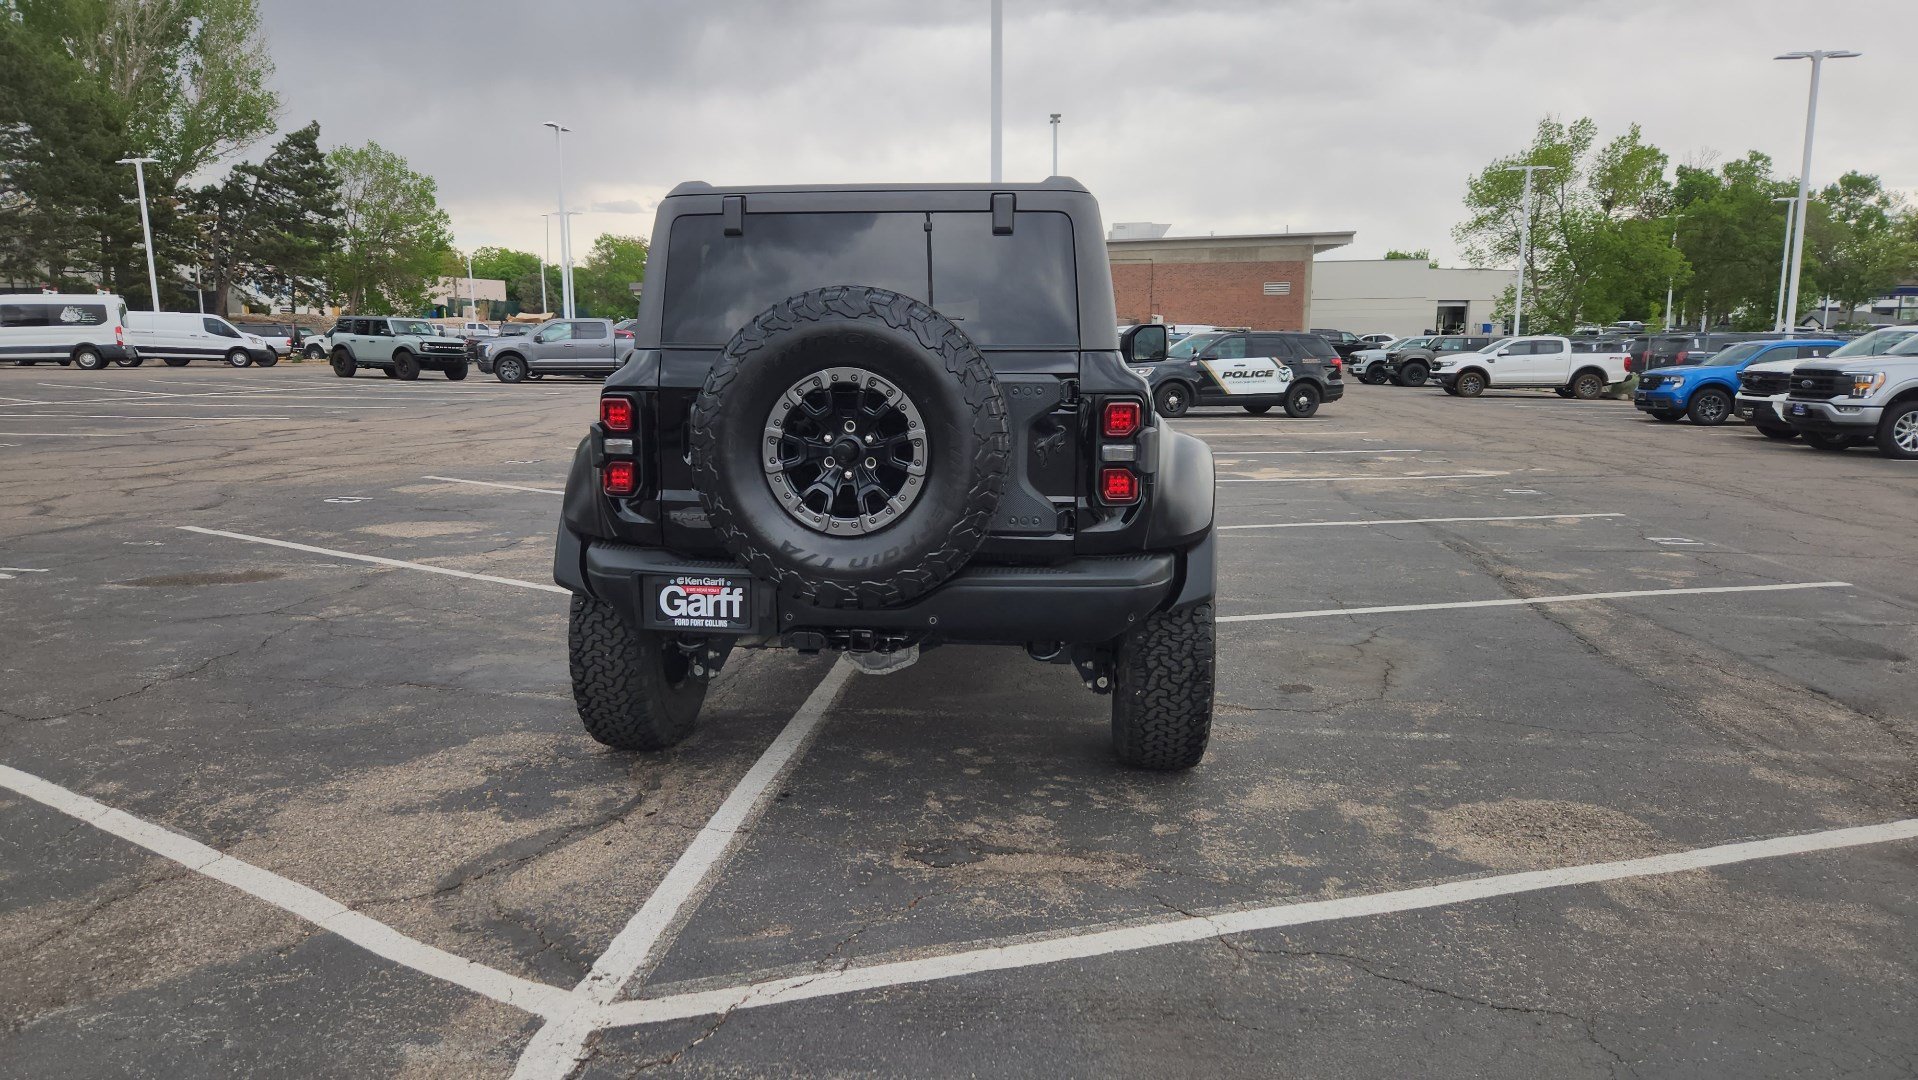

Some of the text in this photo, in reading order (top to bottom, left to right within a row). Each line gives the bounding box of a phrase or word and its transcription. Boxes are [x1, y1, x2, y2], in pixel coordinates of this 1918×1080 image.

[1222, 370, 1274, 379] POLICE
[685, 577, 725, 586] Ken Garff
[660, 585, 743, 618] Garff
[674, 618, 728, 627] FORD FORT COLLINS
